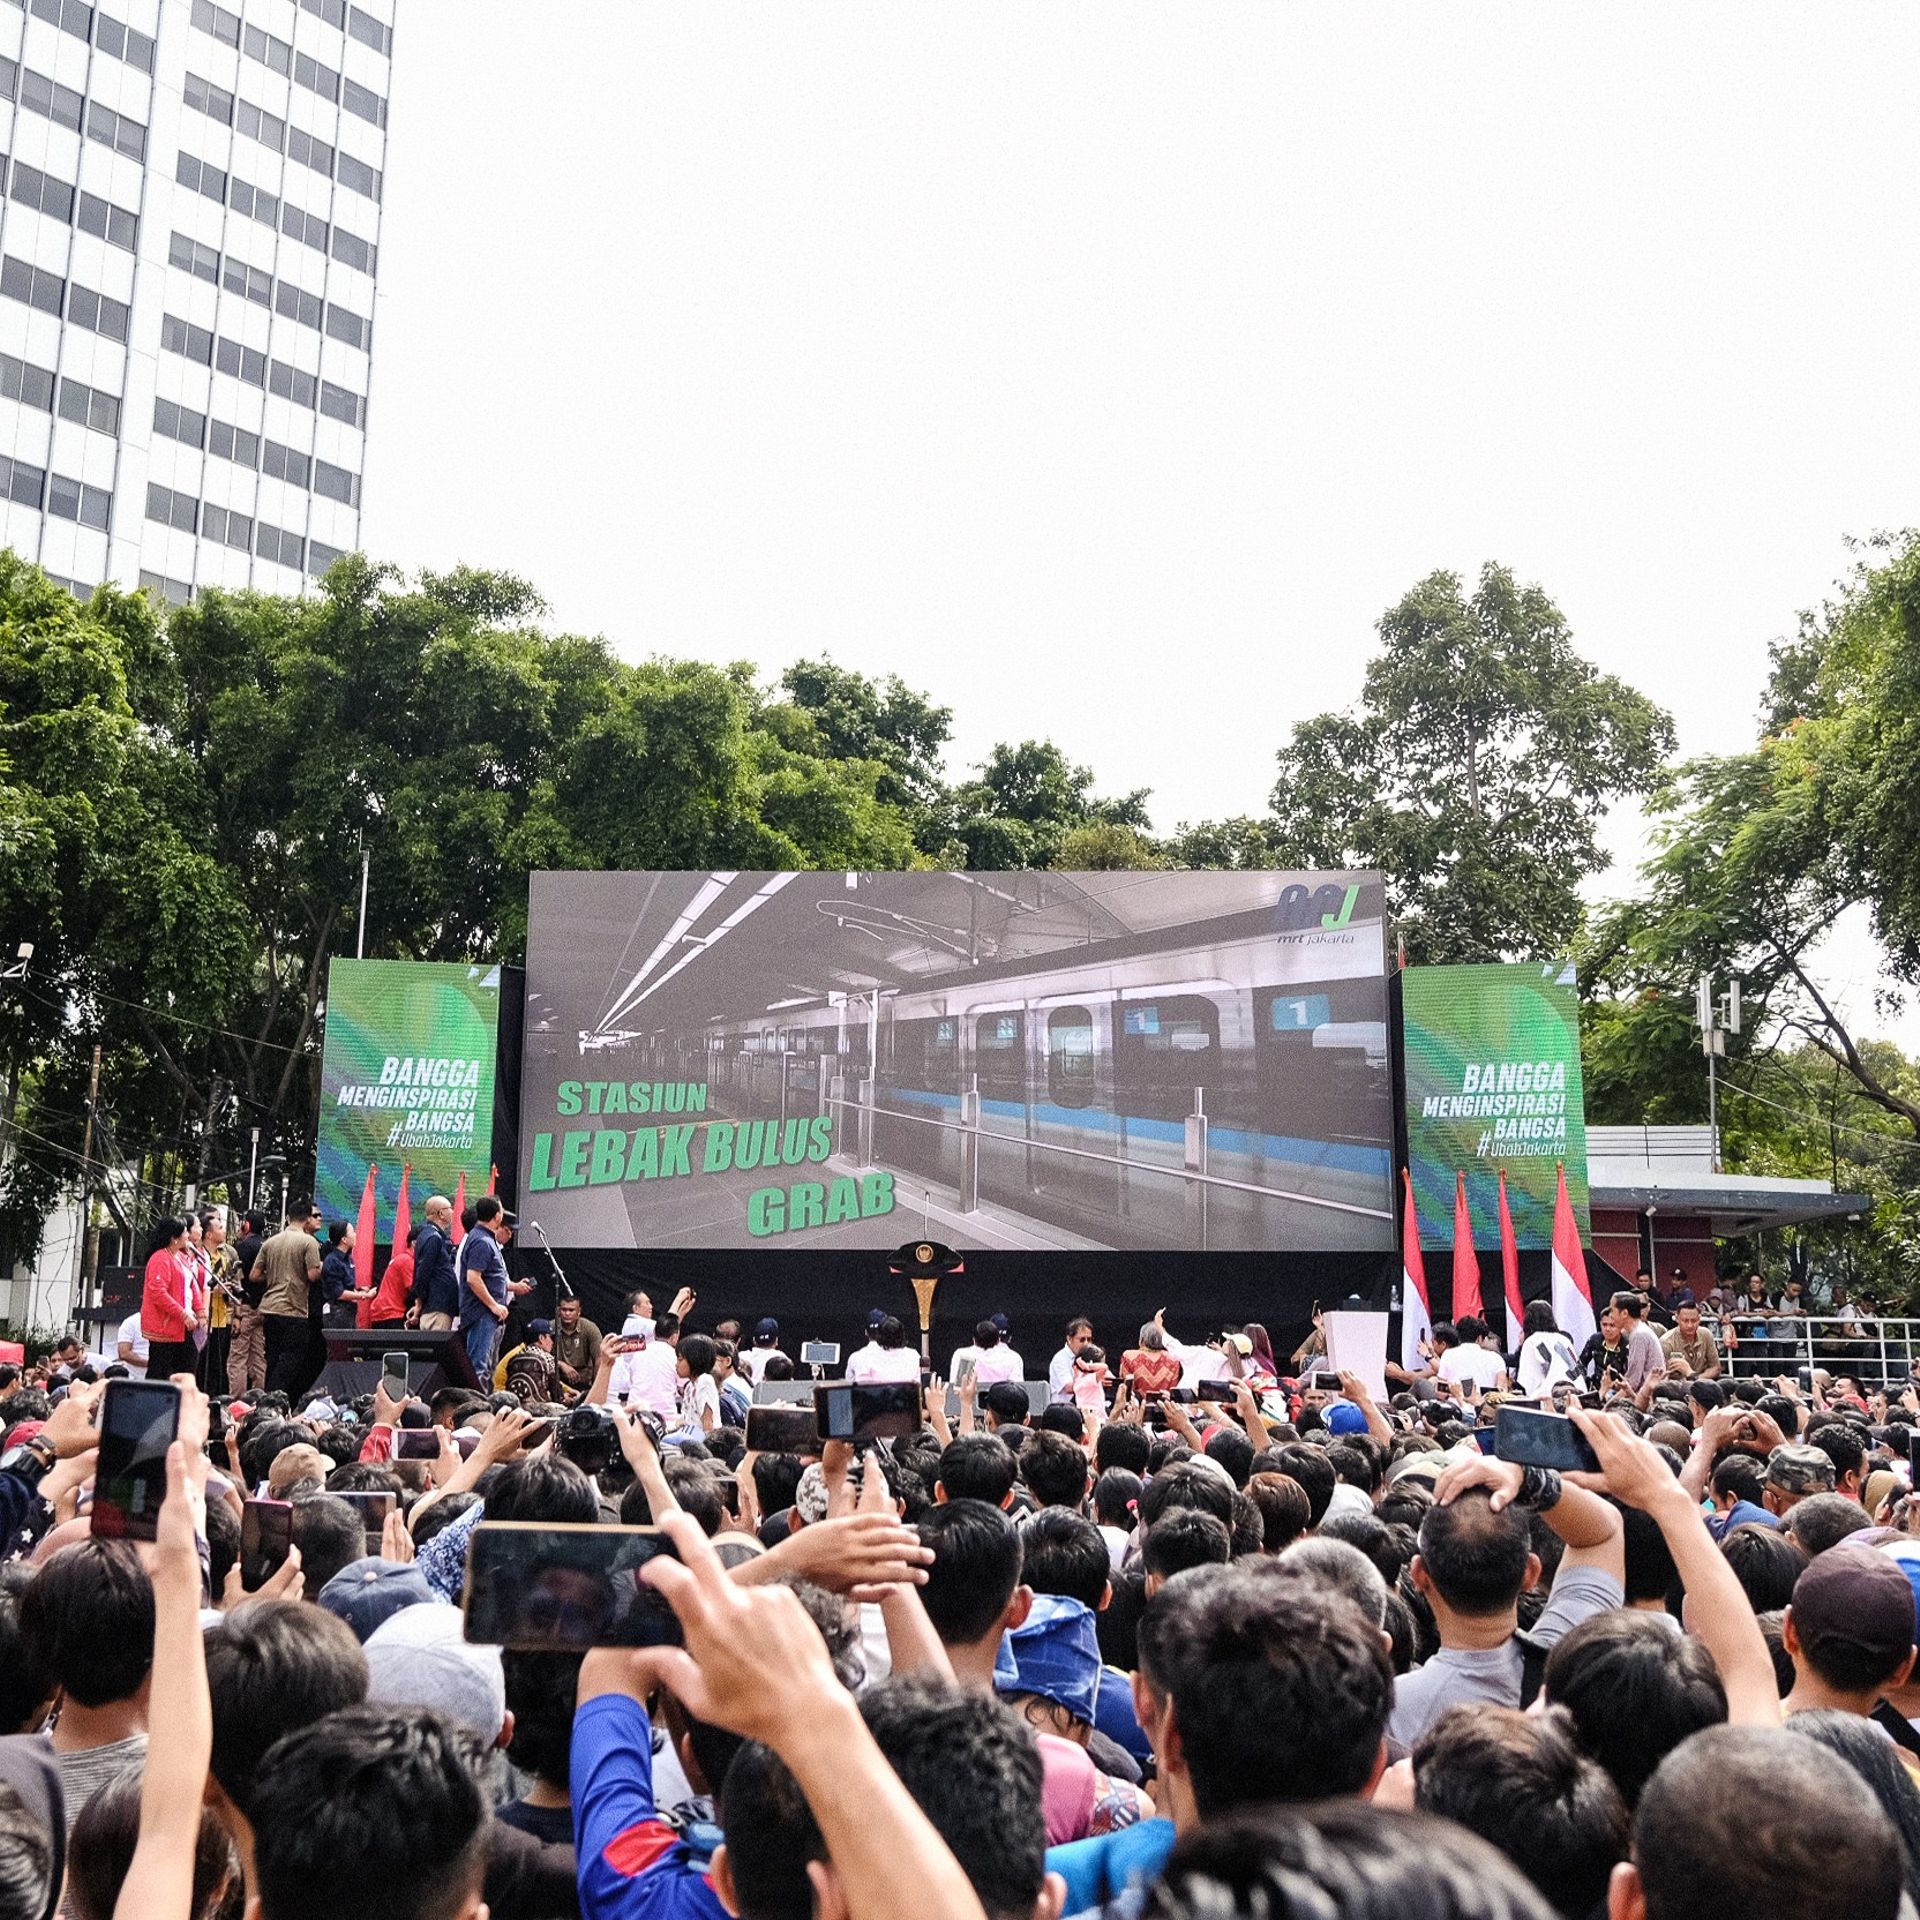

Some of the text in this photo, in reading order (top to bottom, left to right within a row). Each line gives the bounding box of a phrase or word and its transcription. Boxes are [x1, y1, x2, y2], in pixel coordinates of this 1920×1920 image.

[1289, 1000, 1308, 1025] 1
[380, 1056, 480, 1088] BANGGA
[1462, 1061, 1565, 1094] BANGGA
[337, 1086, 477, 1110] MENGINSPIRASI
[556, 1080, 708, 1115] STASIUN
[1422, 1093, 1566, 1117] MENGINSPIRASI
[405, 1111, 475, 1133] BANGSA
[1494, 1117, 1566, 1139] BANGSA
[528, 1116, 833, 1192] LEBAK BULUS
[747, 1171, 895, 1238] GRAB
